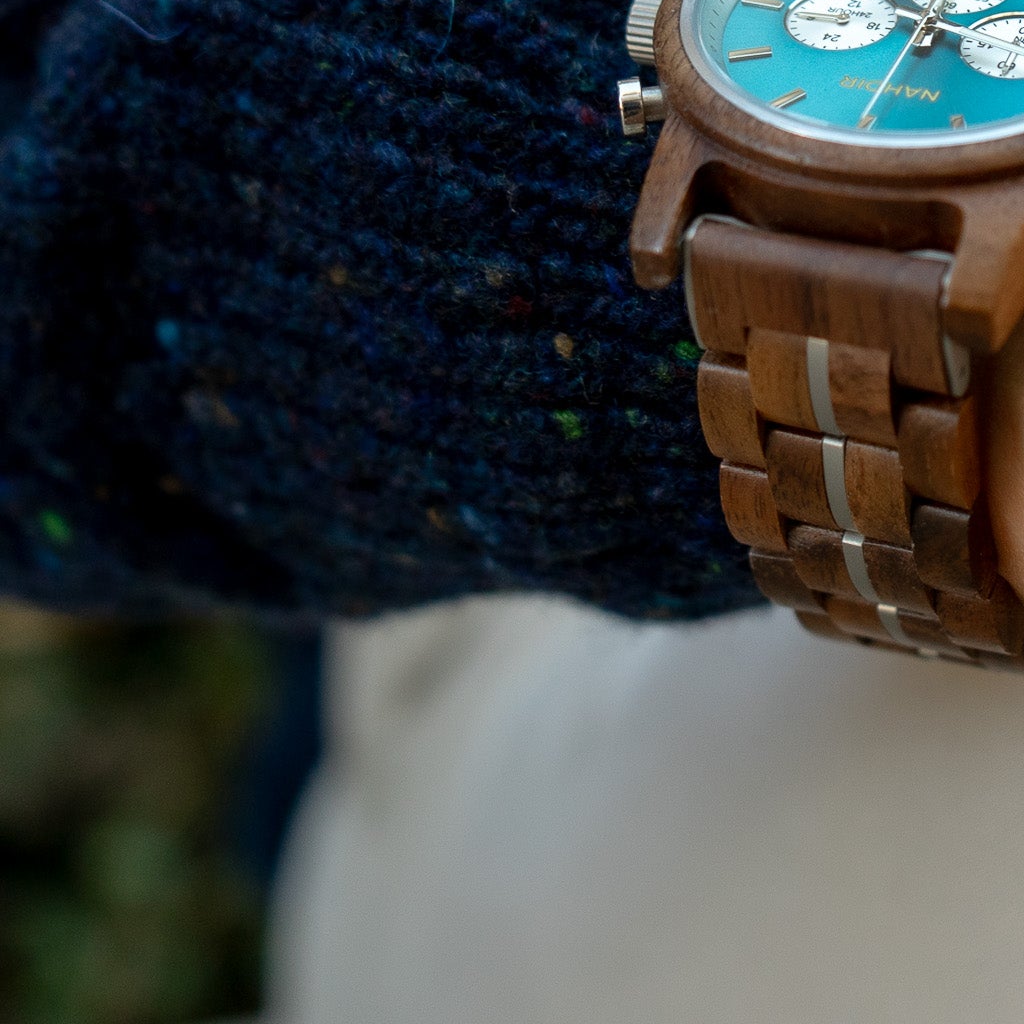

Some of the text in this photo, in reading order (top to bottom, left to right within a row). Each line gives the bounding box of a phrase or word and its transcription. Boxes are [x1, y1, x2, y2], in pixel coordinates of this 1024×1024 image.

[847, 0, 862, 9] 12
[866, 22, 881, 31] 18
[822, 33, 841, 42] 24
